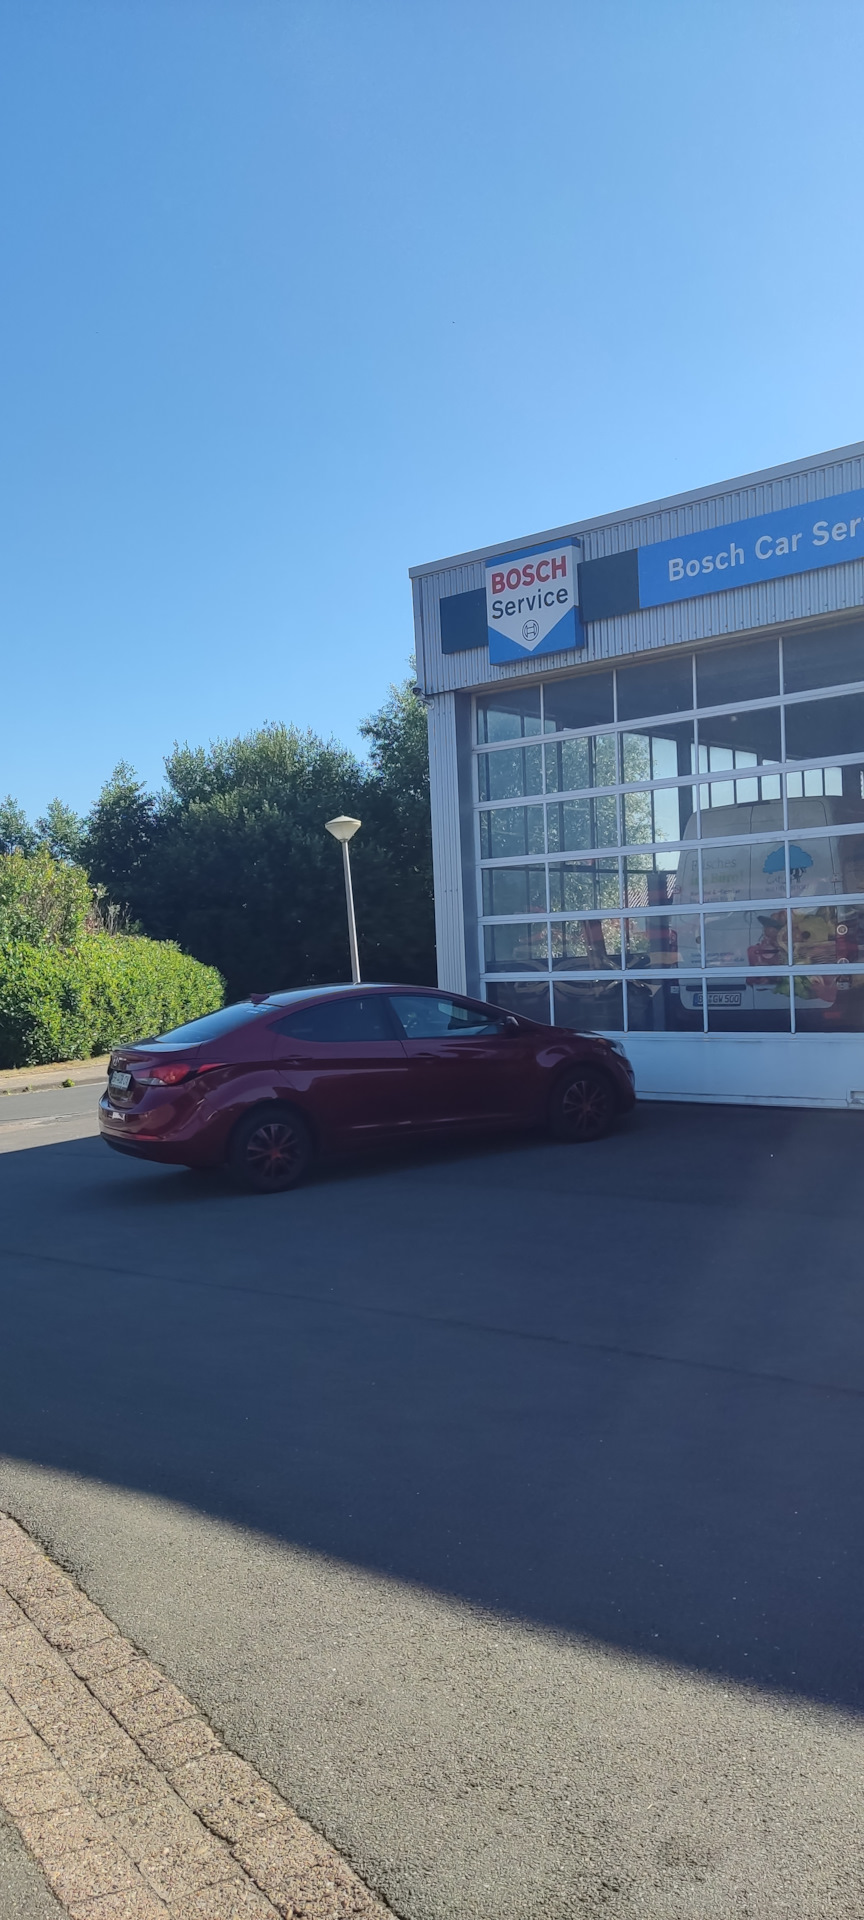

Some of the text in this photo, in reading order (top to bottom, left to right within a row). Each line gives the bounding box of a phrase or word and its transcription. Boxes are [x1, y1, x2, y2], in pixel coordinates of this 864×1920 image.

[668, 517, 864, 581] Bosch Car Ser
[491, 555, 567, 594] BOSCH
[492, 588, 568, 619] Service
